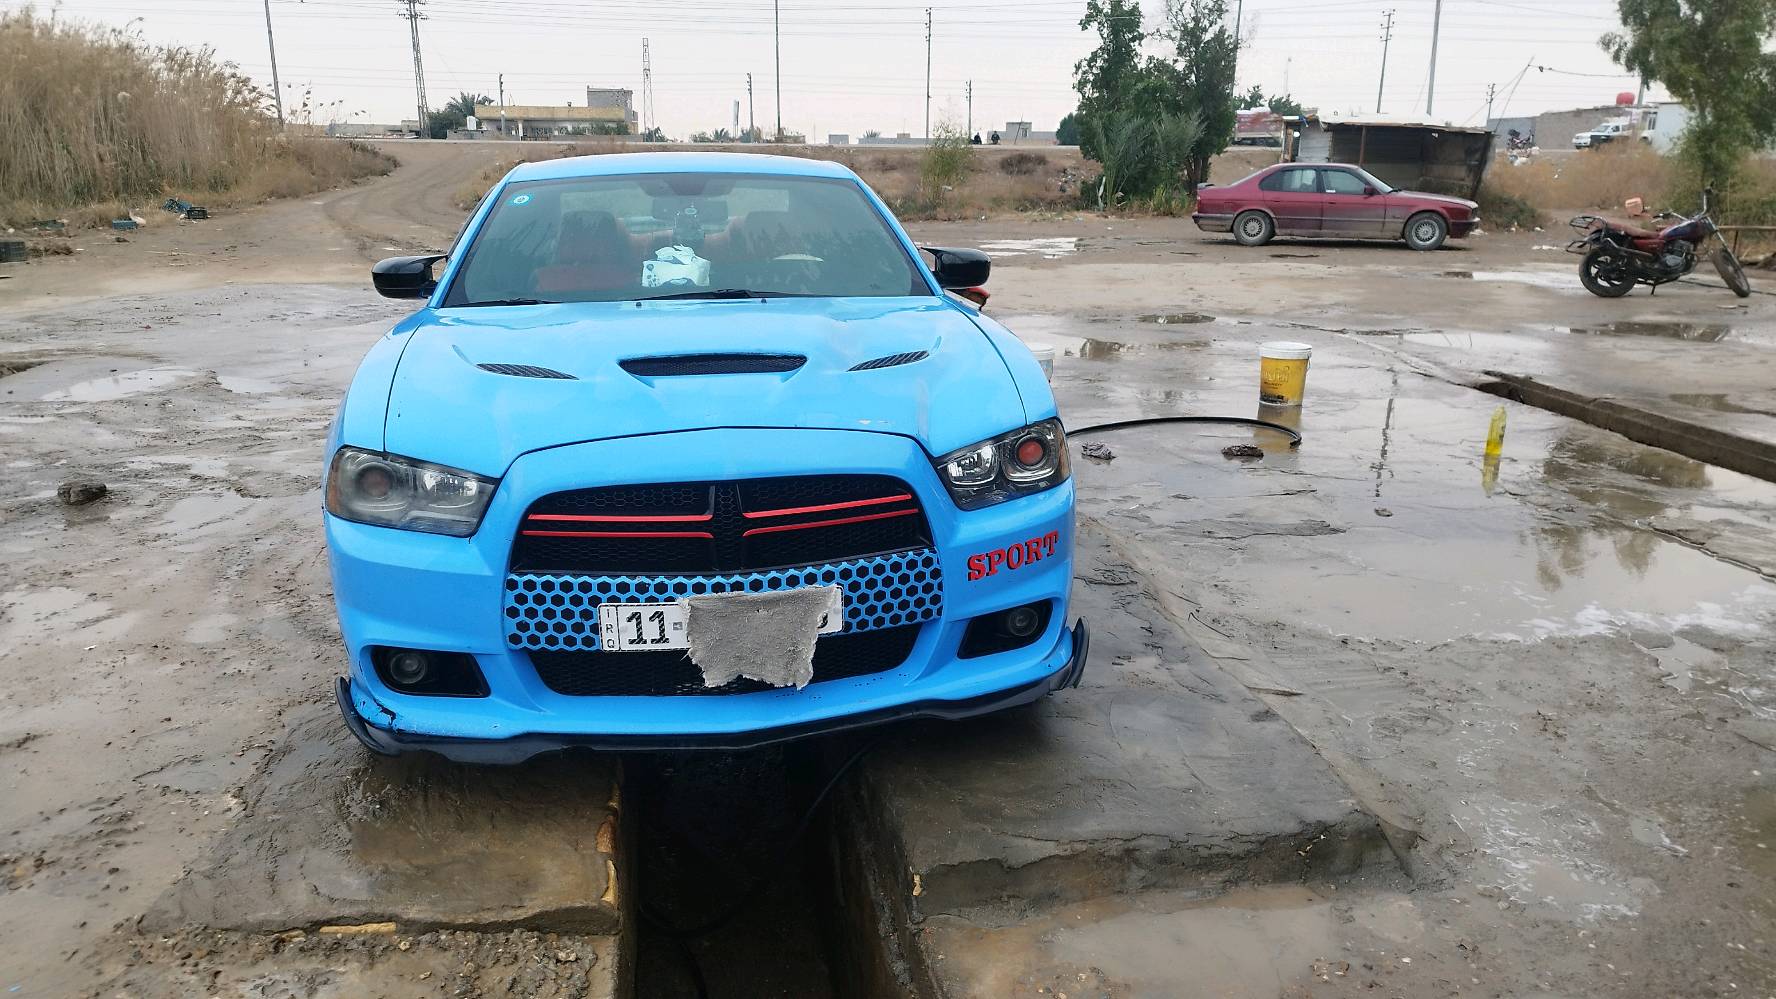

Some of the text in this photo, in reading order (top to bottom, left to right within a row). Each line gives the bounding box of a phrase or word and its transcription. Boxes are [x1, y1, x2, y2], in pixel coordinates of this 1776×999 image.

[967, 530, 1059, 581] SPORT
[605, 608, 615, 648] IRQ
[626, 610, 670, 645] 11
